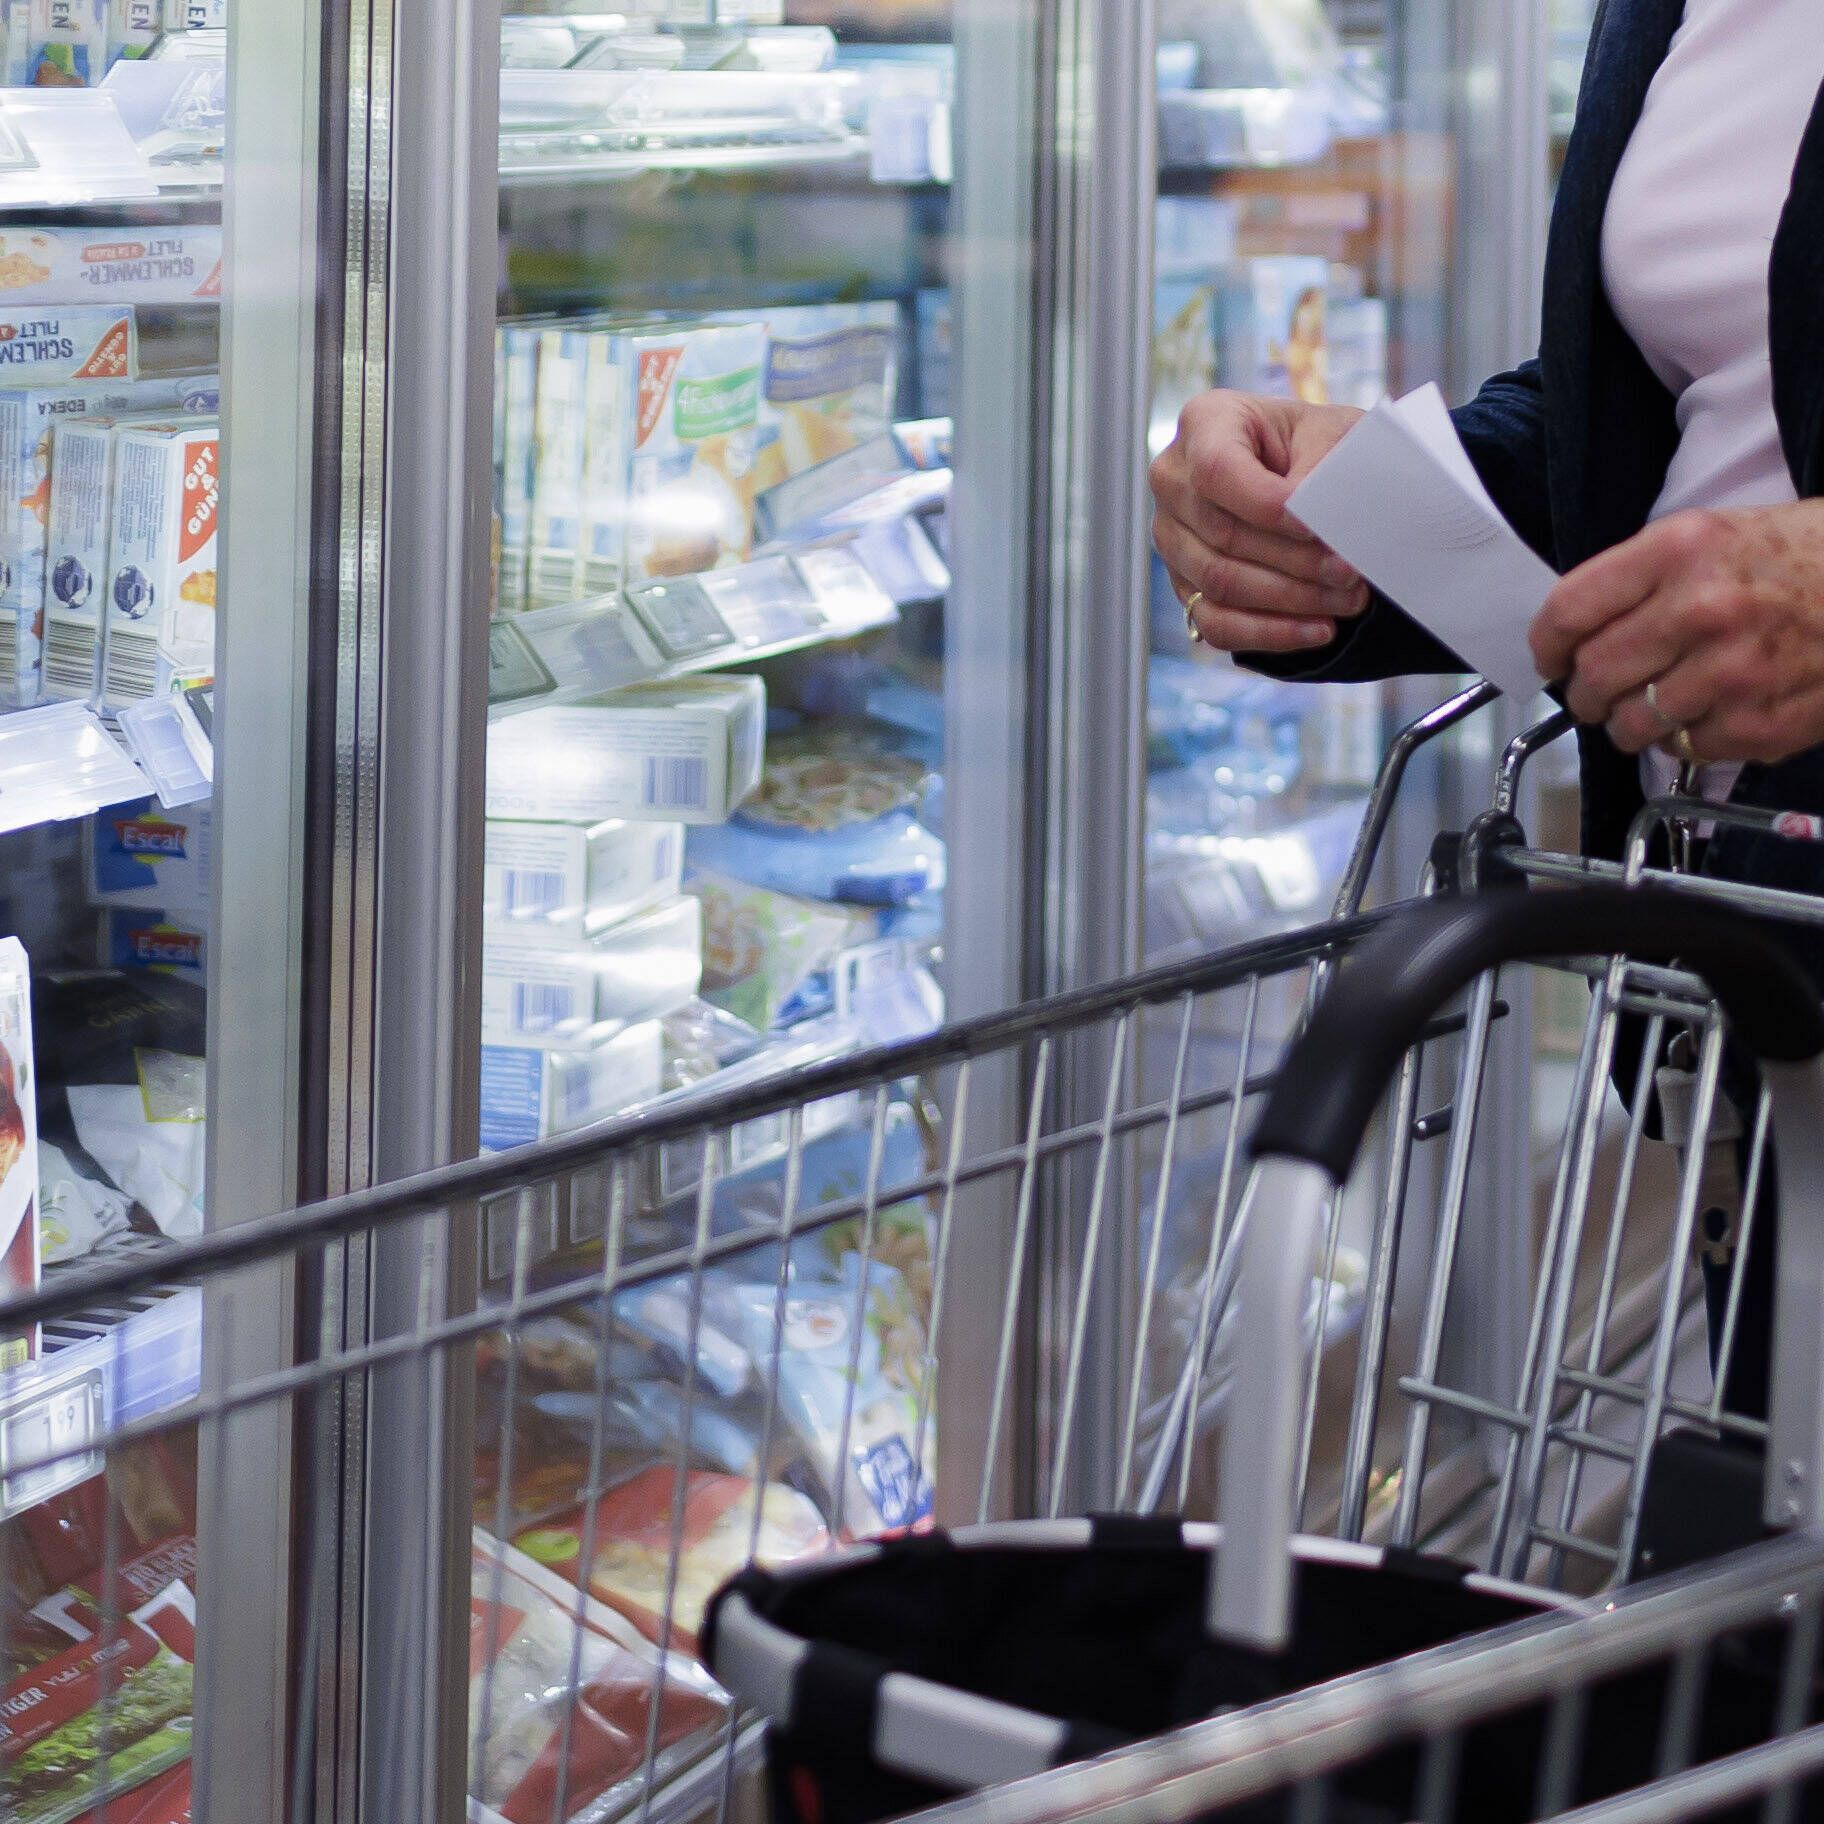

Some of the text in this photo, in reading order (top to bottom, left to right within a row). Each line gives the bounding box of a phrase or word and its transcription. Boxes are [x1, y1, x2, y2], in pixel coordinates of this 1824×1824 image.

[146, 239, 183, 256] FILET
[17, 320, 59, 337] FILET
[37, 398, 86, 416] EDEKA
[184, 446, 215, 490] GUT
[124, 827, 180, 852] Escal
